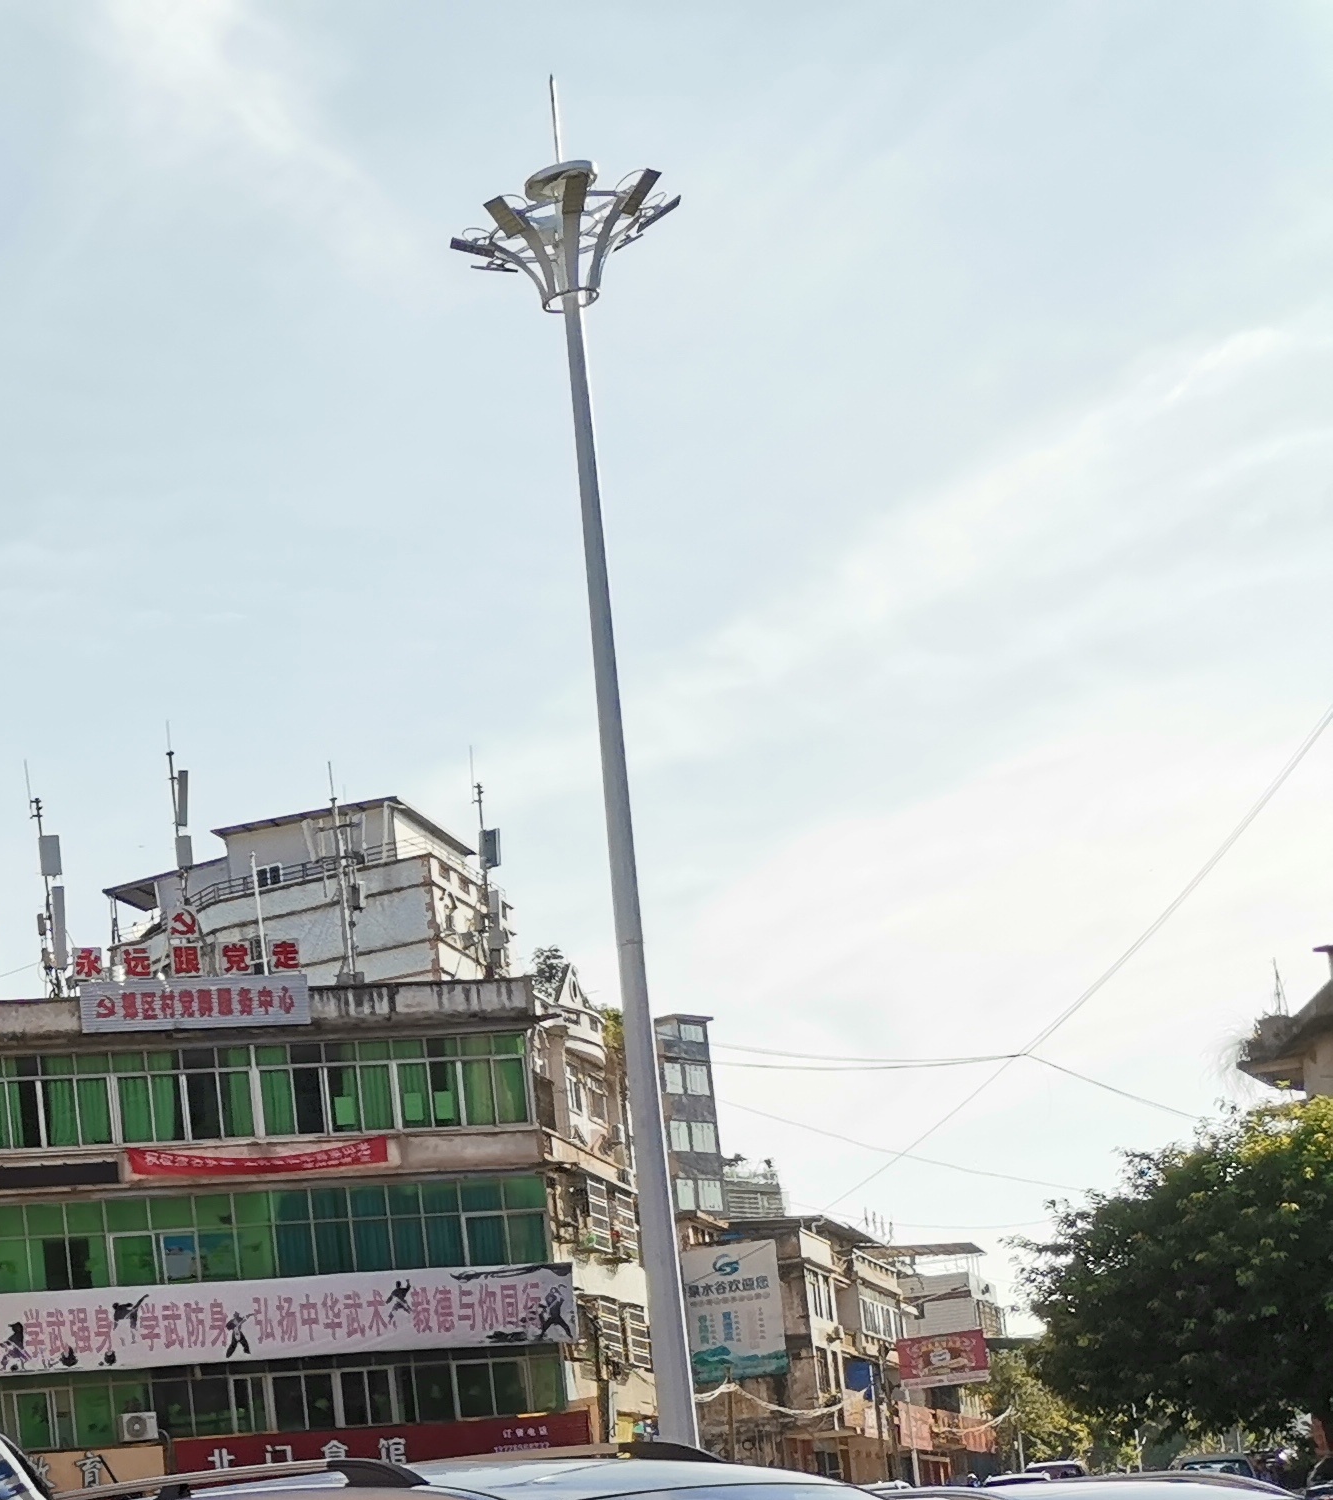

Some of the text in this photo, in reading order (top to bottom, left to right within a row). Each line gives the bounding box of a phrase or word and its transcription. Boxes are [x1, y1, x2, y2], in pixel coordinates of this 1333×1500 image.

[75, 941, 300, 979] 永远跟党走
[23, 1304, 114, 1357] 学武强身
[139, 1297, 229, 1351] 学武防身
[252, 1289, 392, 1345] 弘扬中华武术
[207, 1437, 407, 1470] 北门食馆
